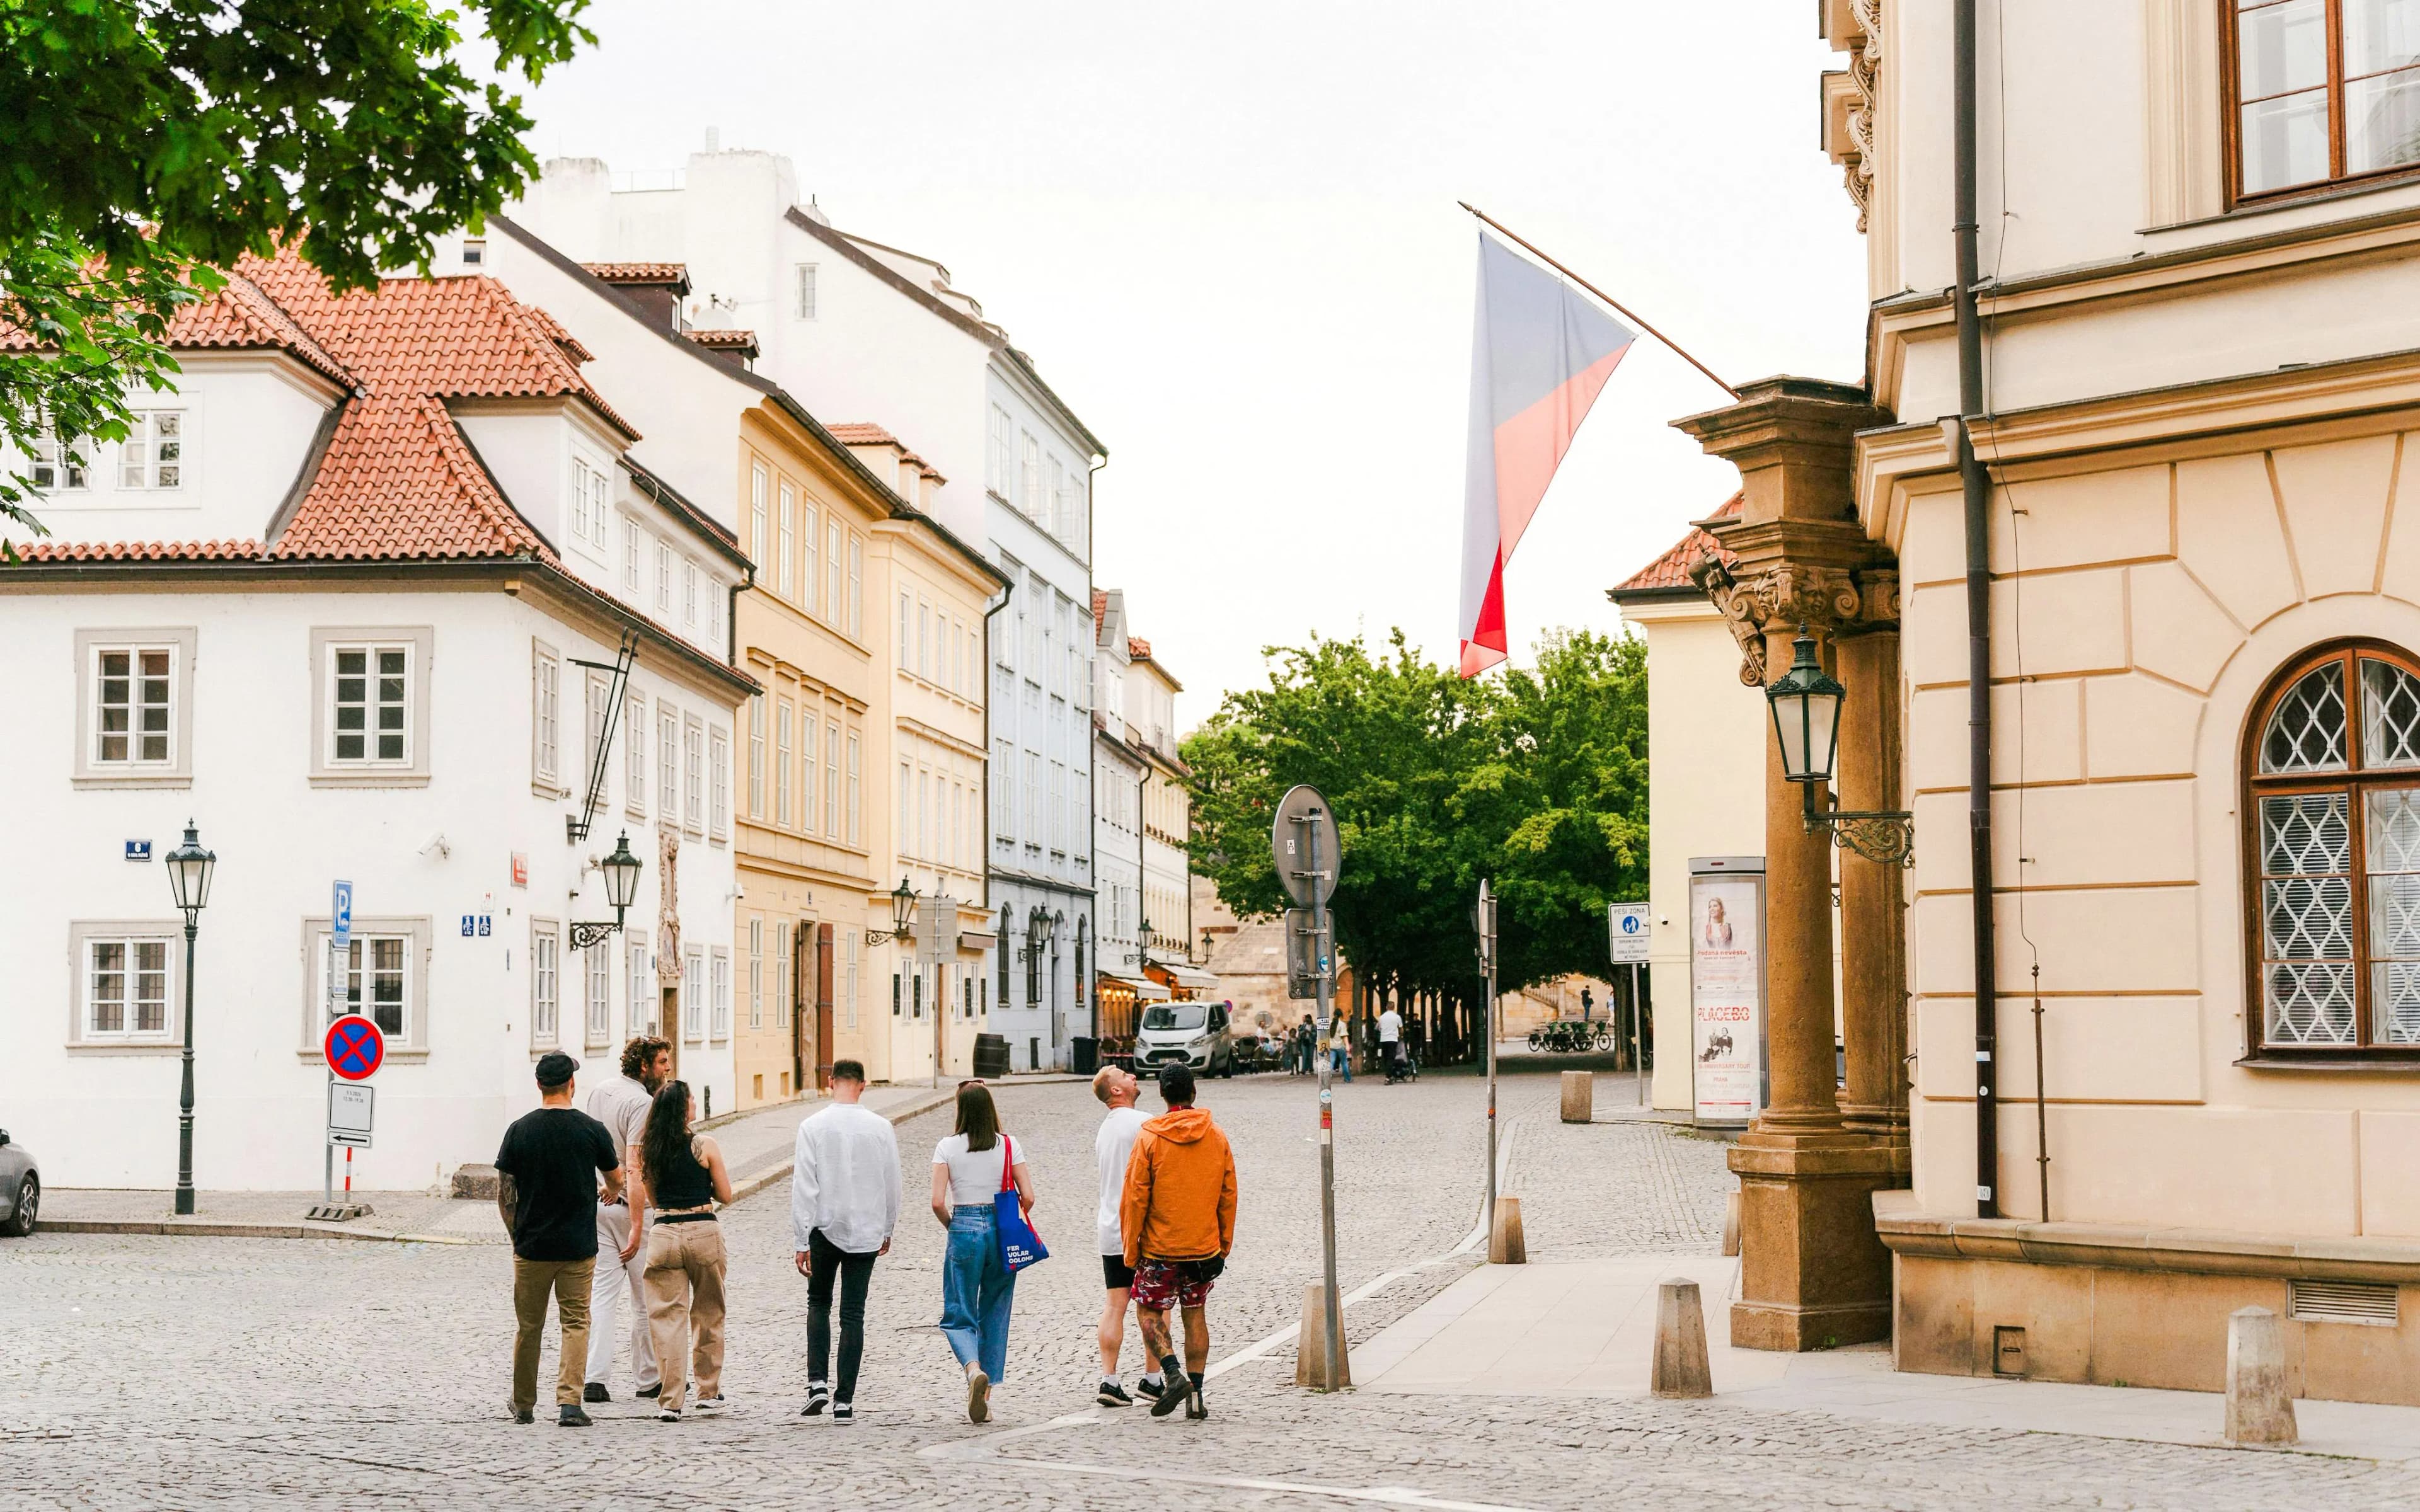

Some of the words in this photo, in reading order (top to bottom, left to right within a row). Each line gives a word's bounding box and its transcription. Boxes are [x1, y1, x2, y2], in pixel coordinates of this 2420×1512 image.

[134, 842, 142, 852] 6
[338, 889, 349, 927] P
[1698, 1007, 1749, 1021] PLACEBO
[1008, 1250, 1029, 1258] VOLAR
